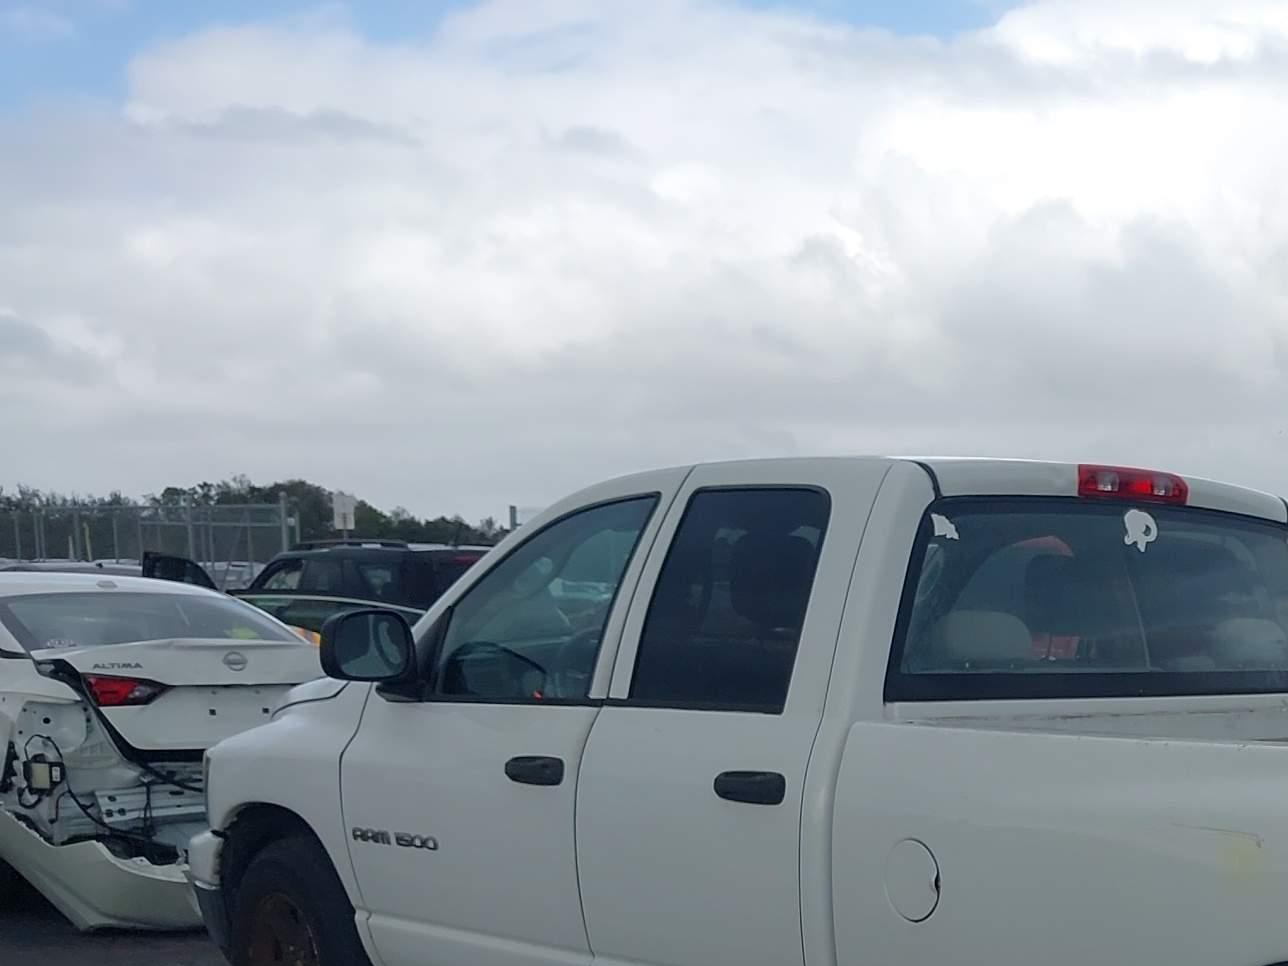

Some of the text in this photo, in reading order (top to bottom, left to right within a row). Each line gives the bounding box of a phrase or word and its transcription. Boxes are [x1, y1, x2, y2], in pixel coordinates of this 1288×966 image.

[92, 662, 144, 670] ALTIMA
[352, 826, 439, 851] RAM 1500
